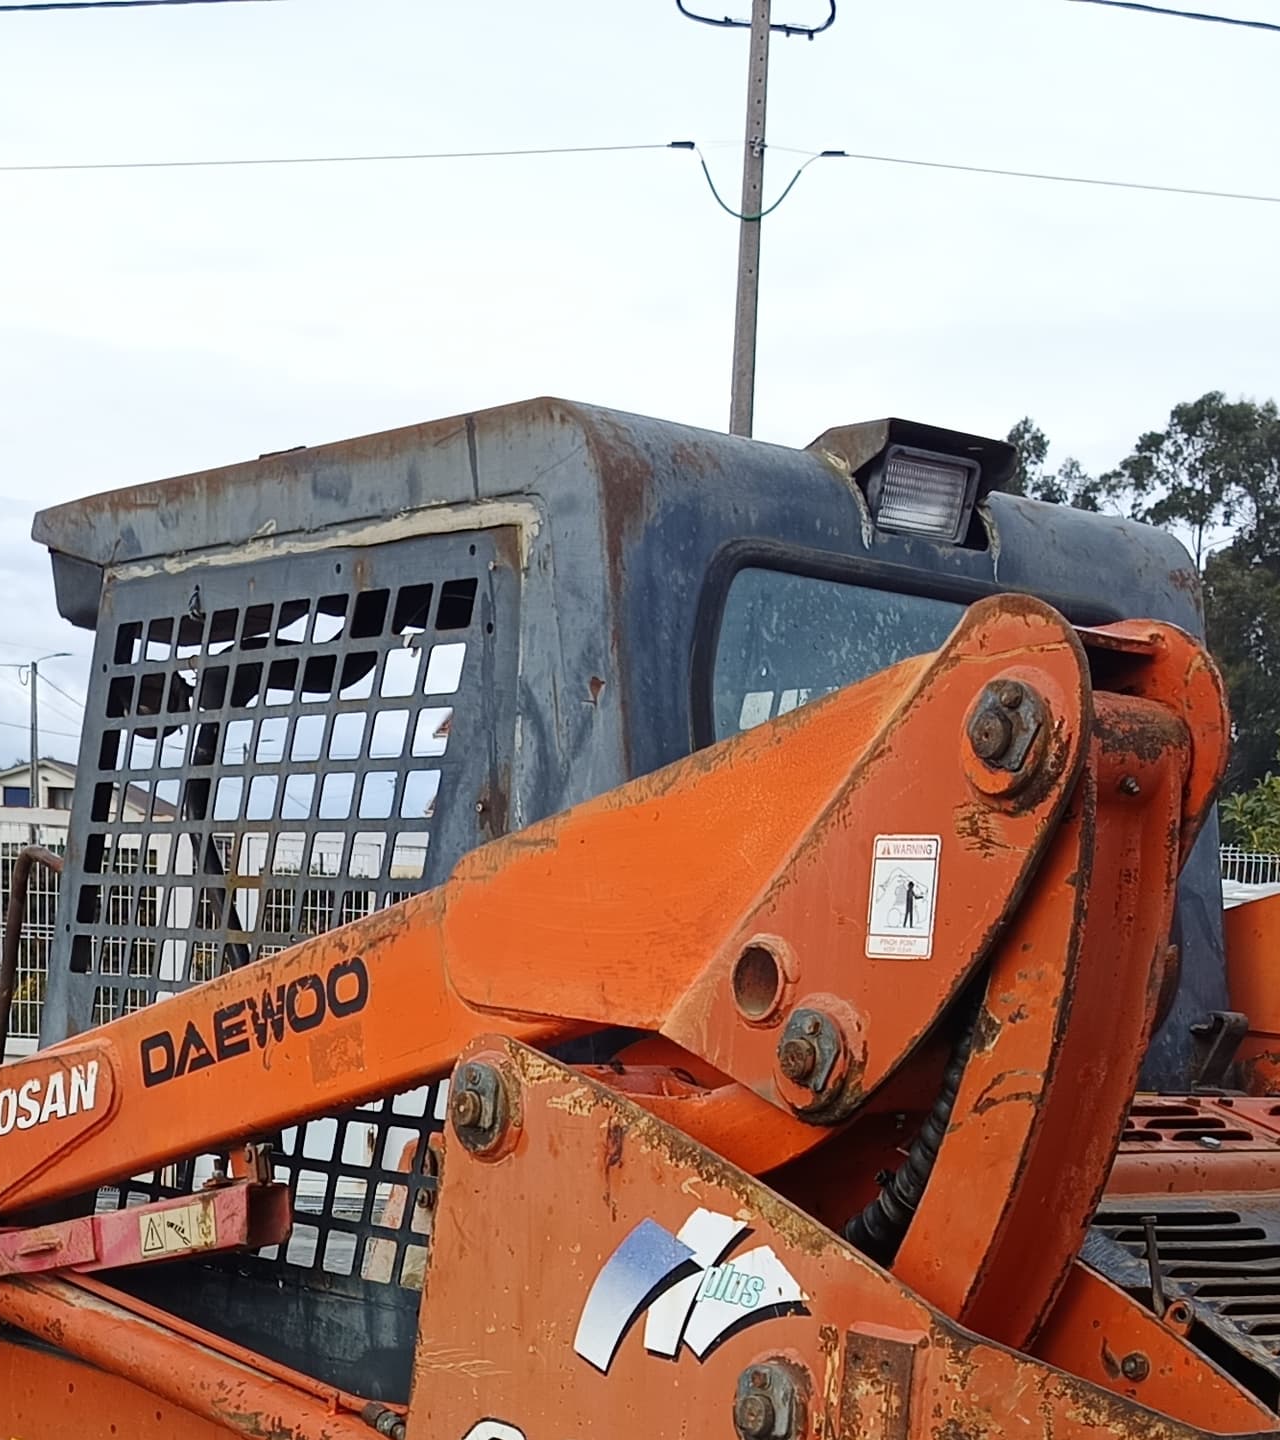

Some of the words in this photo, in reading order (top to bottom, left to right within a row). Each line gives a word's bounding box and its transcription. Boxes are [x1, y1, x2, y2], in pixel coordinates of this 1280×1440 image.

[892, 843, 933, 856] WARNING
[140, 956, 370, 1089] DAEWOO
[699, 1262, 767, 1309] plus
